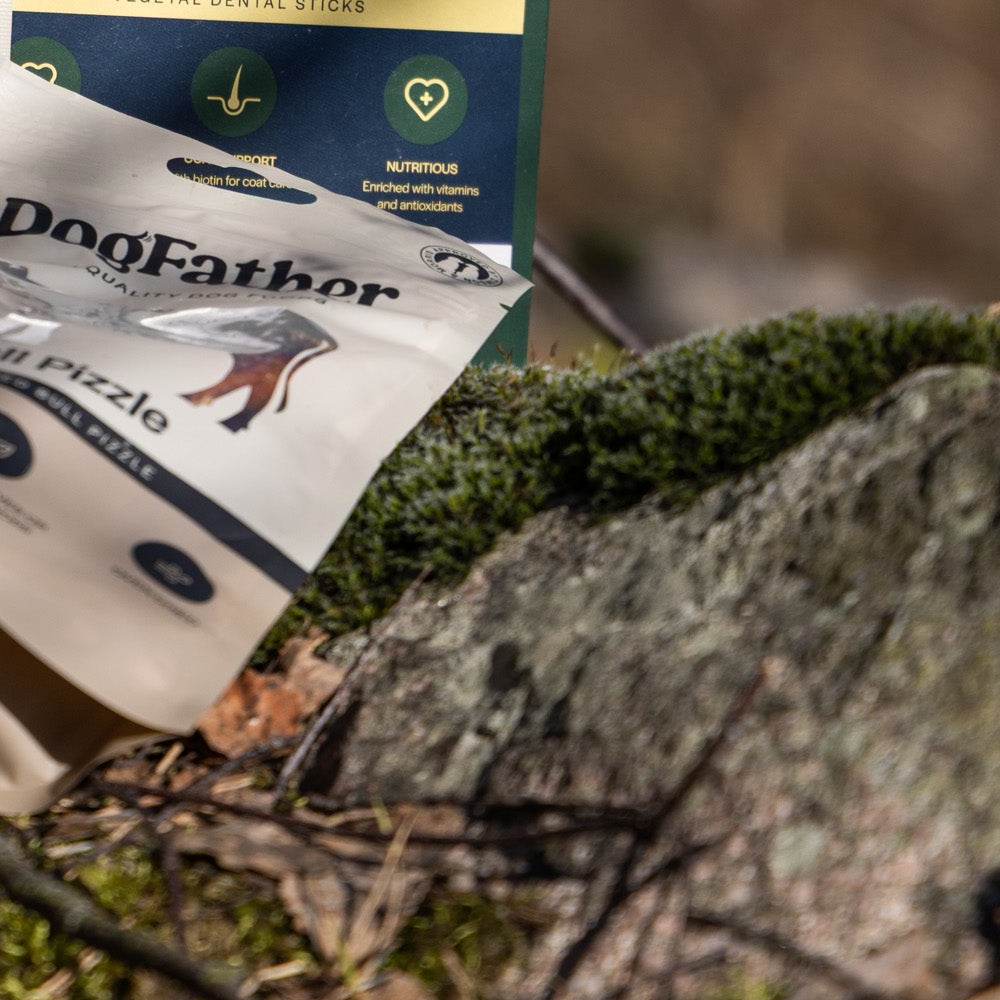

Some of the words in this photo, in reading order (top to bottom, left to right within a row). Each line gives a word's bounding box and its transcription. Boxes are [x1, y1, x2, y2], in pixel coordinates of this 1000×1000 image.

[386, 160, 459, 176] NUTRITIOUS
[193, 173, 223, 186] biotin
[225, 174, 241, 187] for
[242, 177, 267, 188] coat
[362, 180, 410, 194] Enriched
[412, 183, 434, 195] with
[436, 184, 480, 197] vitamins
[377, 199, 398, 211] and
[399, 201, 464, 213] antioxidants
[36, 356, 170, 434] Pizzle
